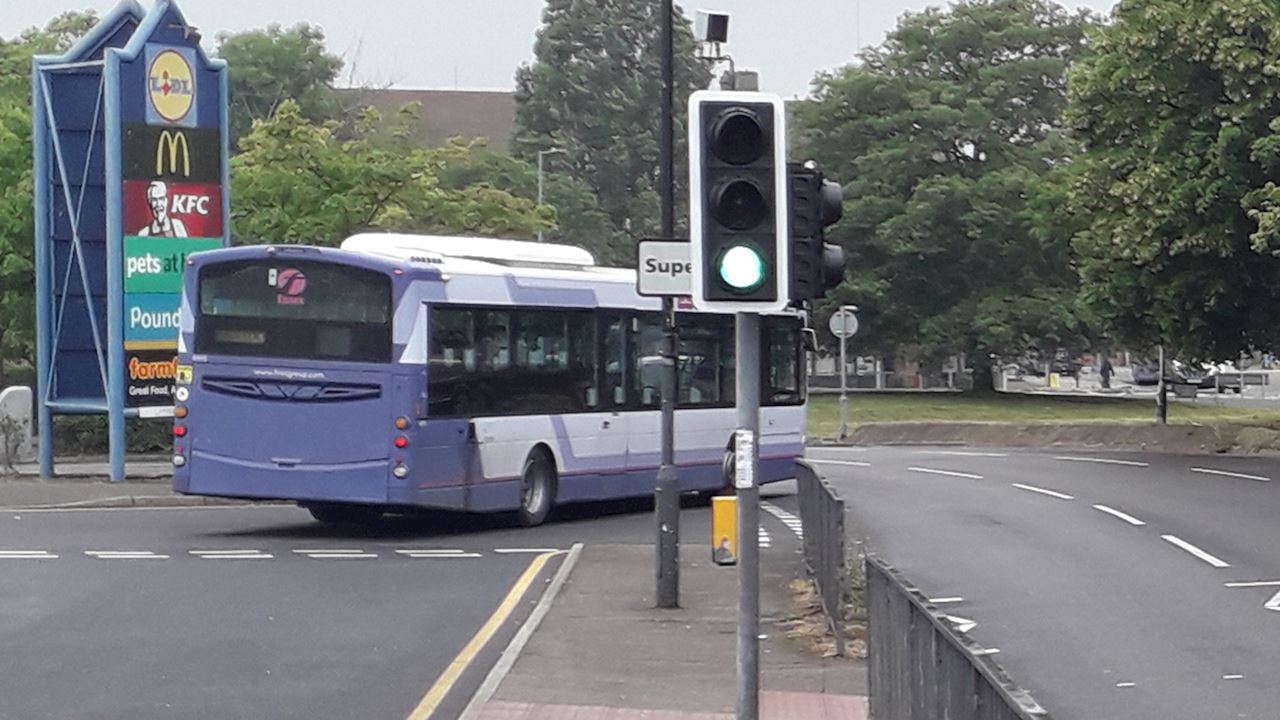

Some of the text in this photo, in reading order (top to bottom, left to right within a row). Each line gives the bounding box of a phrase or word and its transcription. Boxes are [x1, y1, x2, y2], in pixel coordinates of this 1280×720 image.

[171, 195, 209, 215] KFC
[127, 252, 161, 278] pets
[163, 253, 178, 272] at
[130, 306, 181, 329] Pound
